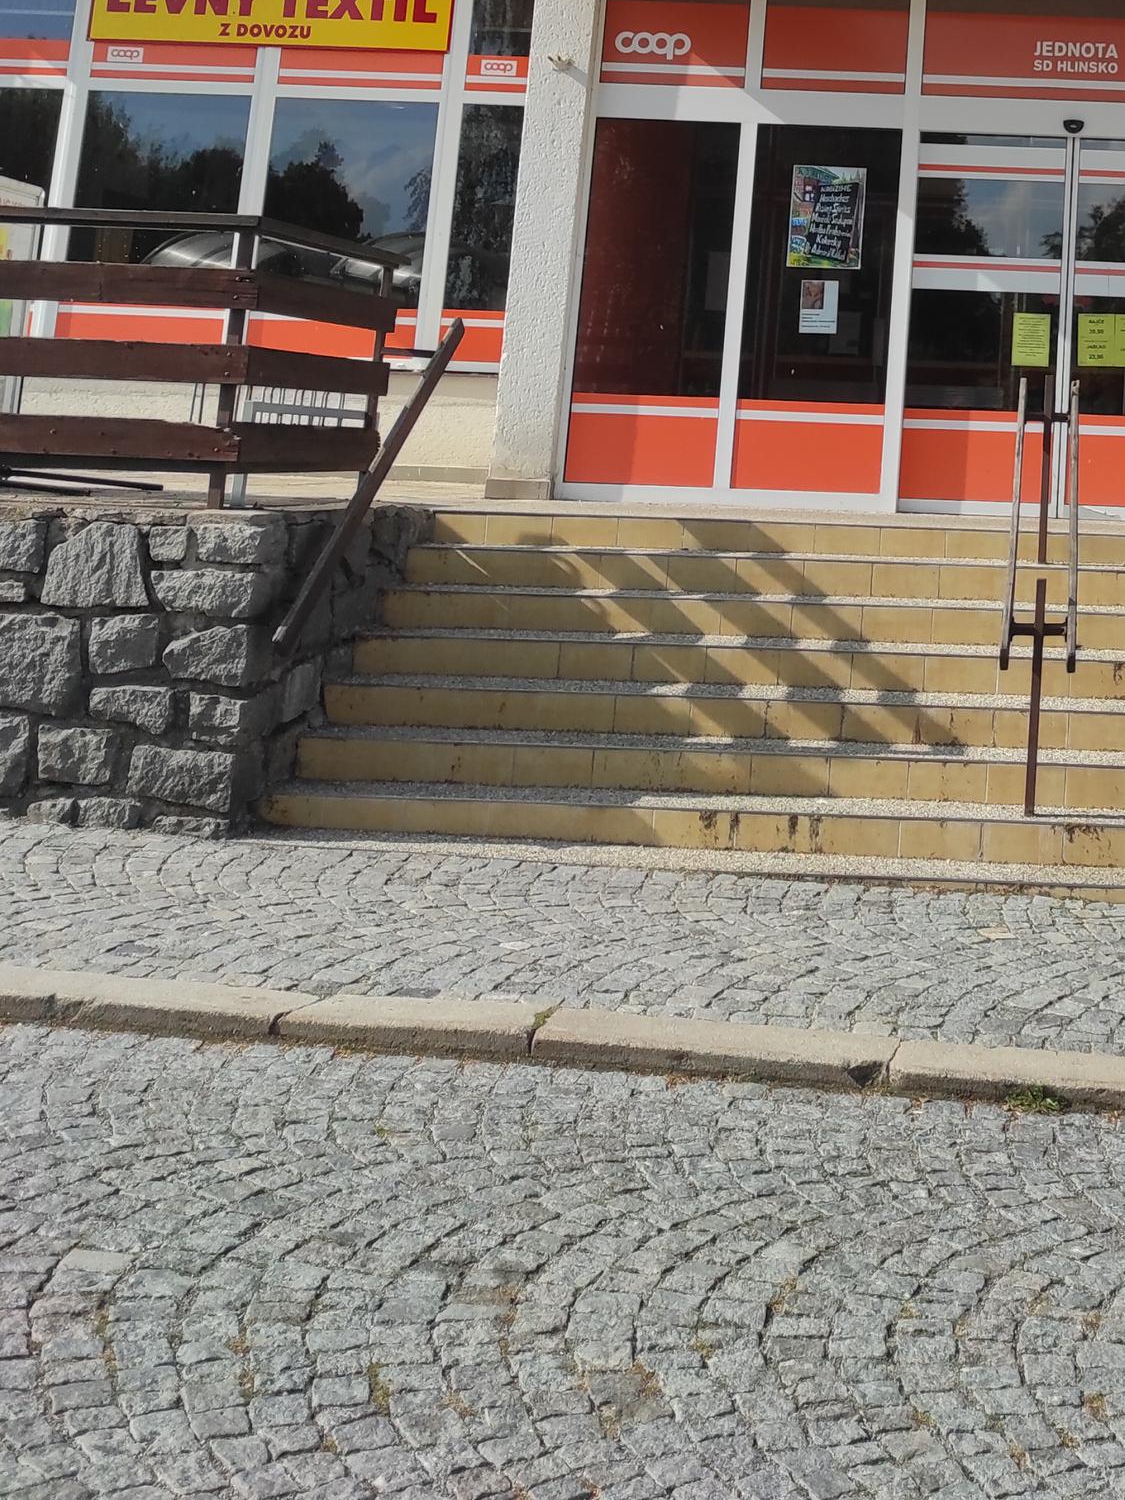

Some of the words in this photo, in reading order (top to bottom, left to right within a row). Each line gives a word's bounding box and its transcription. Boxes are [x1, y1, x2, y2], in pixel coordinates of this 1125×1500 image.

[219, 23, 231, 36] Z
[236, 24, 312, 39] DOVOZU
[615, 31, 691, 60] coop
[1033, 41, 1118, 59] JEDNOTA
[110, 48, 140, 60] coop
[484, 62, 513, 73] coop
[1033, 60, 1052, 72] SD
[1057, 61, 1118, 74] HLINSKO
